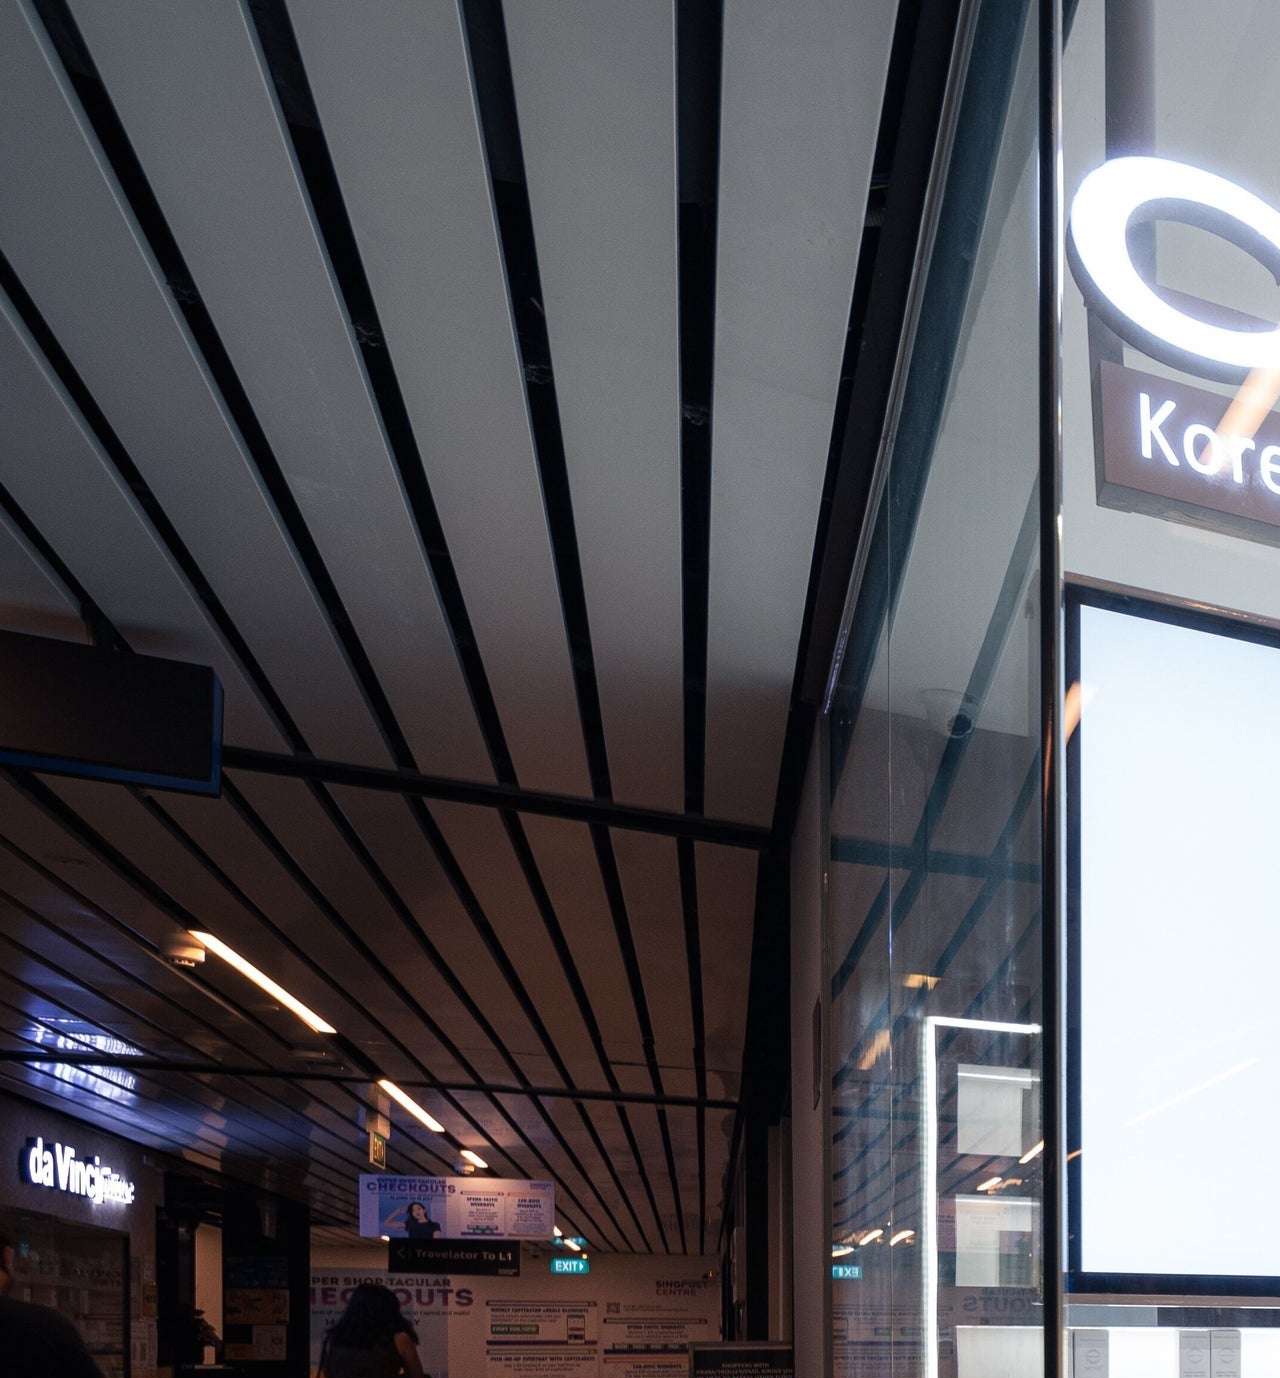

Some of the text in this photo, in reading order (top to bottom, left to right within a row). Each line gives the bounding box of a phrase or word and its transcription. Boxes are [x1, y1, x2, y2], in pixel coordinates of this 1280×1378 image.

[29, 1137, 54, 1187] da
[367, 1182, 456, 1194] CHECKOUTS
[415, 1248, 512, 1261] Travelator To L1
[555, 1261, 578, 1271] EXIT
[308, 1287, 474, 1307] ECOUTS
[656, 1288, 697, 1296] CENTRE
